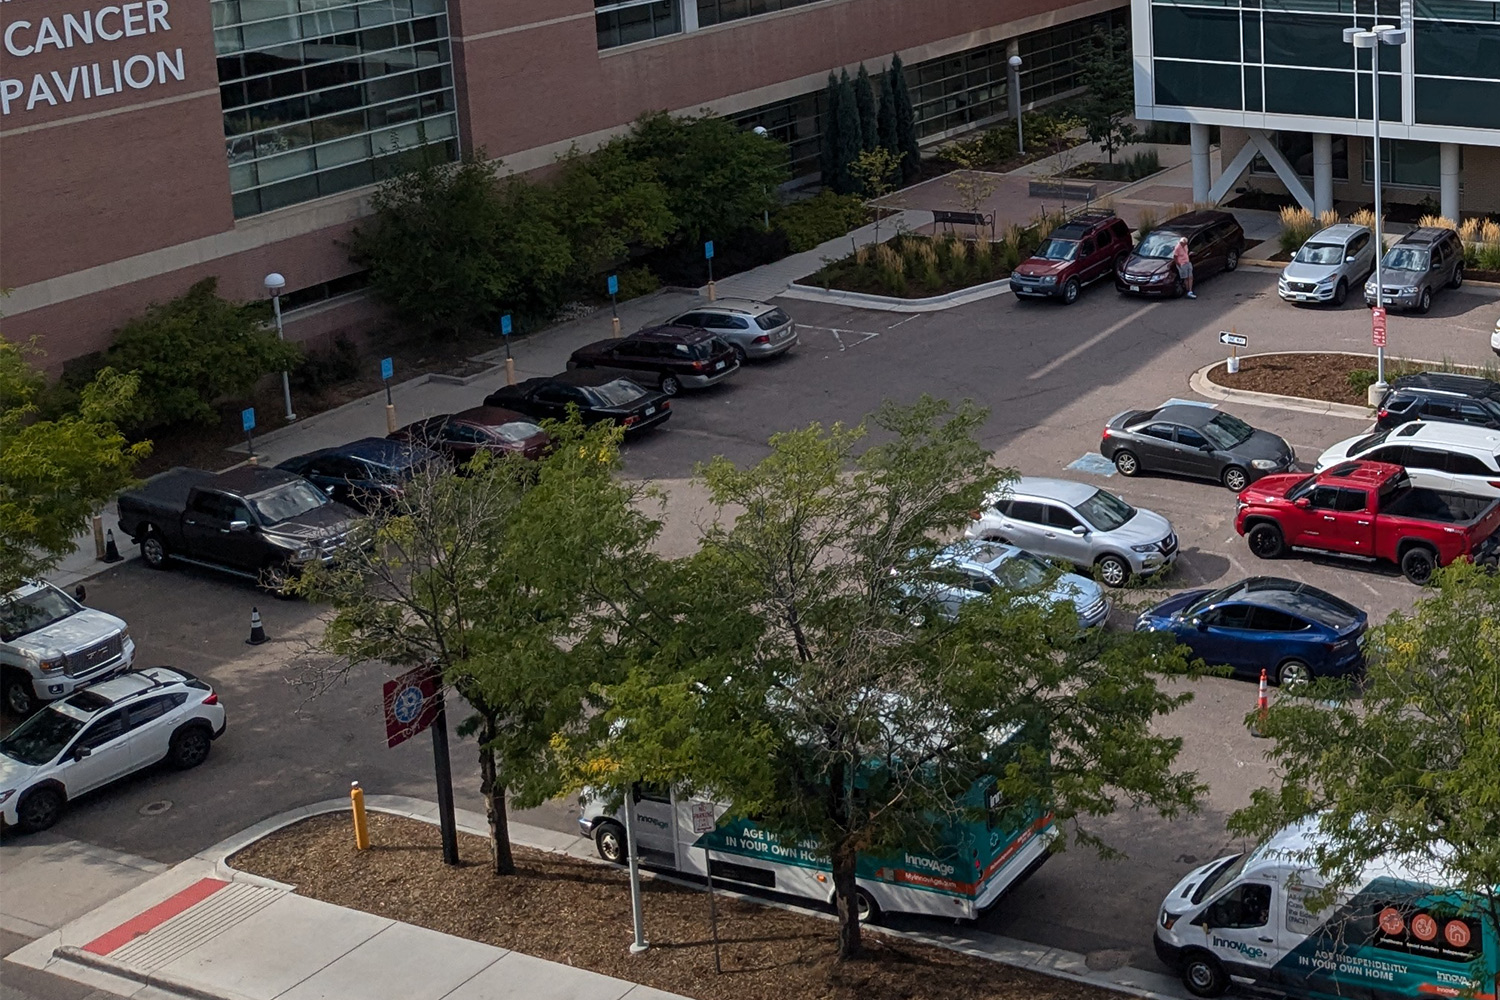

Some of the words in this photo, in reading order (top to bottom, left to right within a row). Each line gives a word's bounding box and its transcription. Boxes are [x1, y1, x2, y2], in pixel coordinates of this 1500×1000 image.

[4, 0, 171, 56] CANCER
[0, 48, 185, 115] PAVILION
[743, 827, 764, 839] AGE
[726, 836, 737, 847] IN
[740, 838, 768, 852] YOUR
[771, 844, 797, 858] OWN
[905, 852, 954, 876] InnovAge
[1213, 936, 1263, 958] InnovAge
[1299, 955, 1308, 965] IN
[1311, 958, 1336, 970] YOUR
[1339, 963, 1362, 975] OWN
[1365, 968, 1393, 981] HOME
[1336, 954, 1407, 974] INDEPENDENTLY
